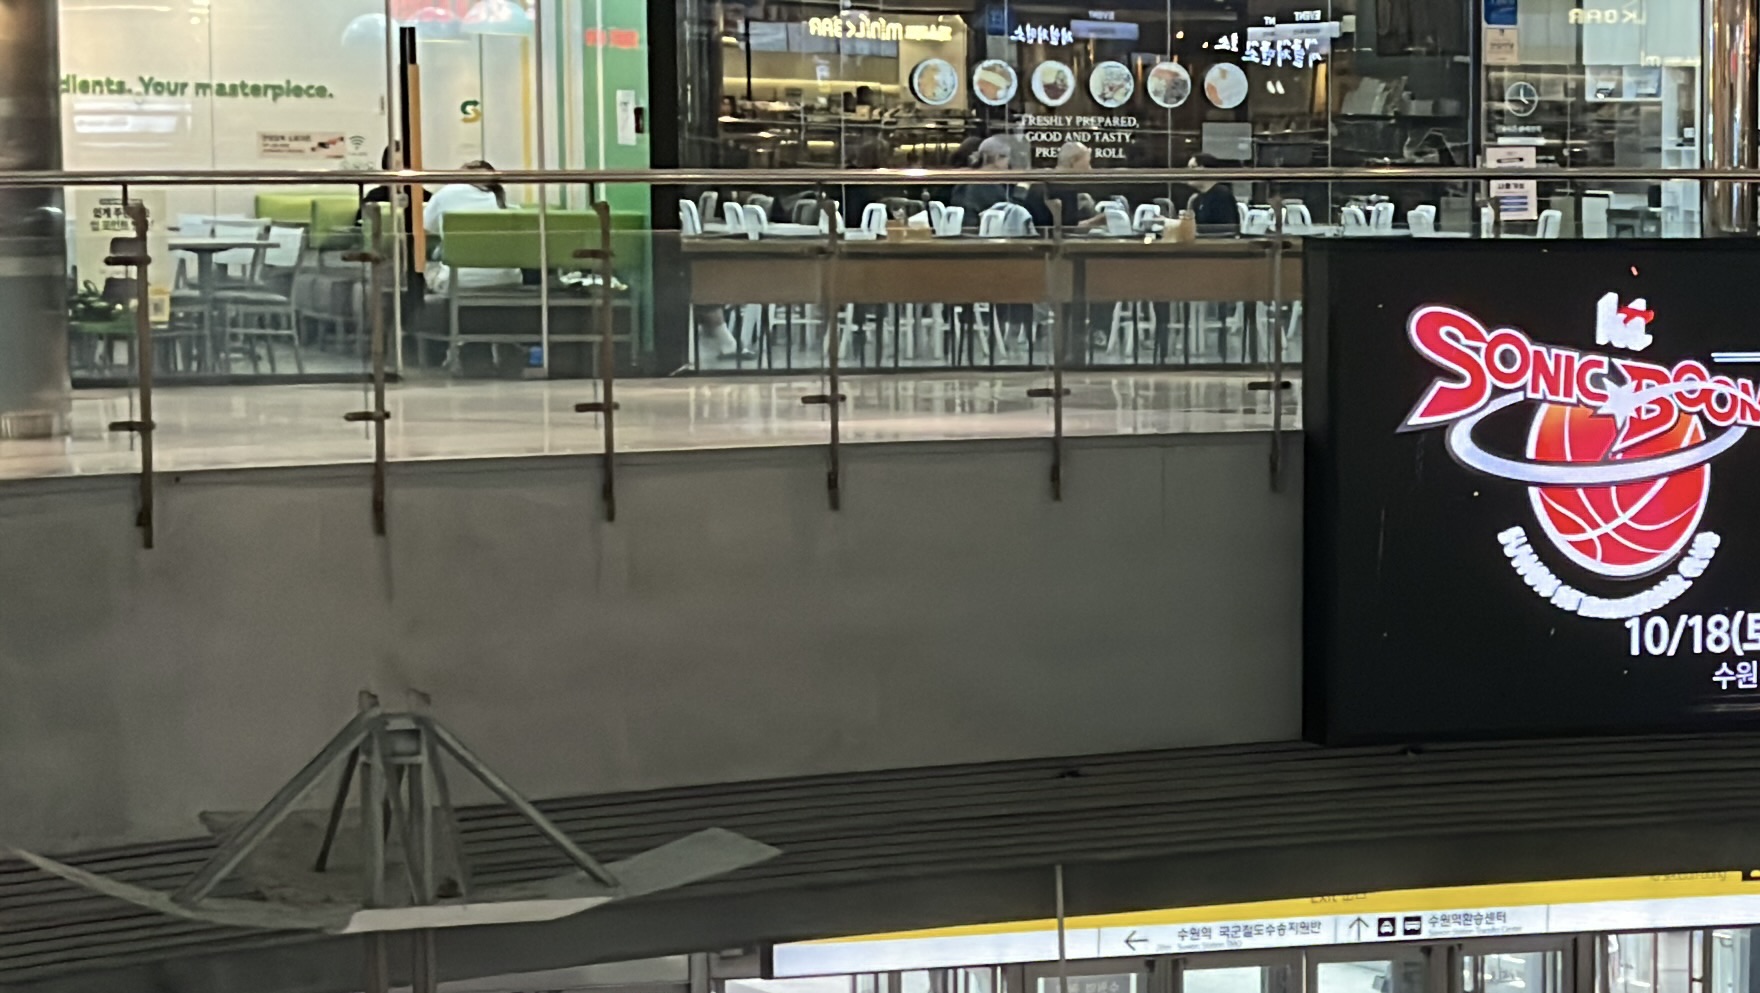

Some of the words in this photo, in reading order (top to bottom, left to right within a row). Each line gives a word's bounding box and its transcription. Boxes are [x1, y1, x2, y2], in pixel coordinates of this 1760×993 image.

[138, 76, 188, 97] Your
[195, 79, 334, 102] masterpiece.
[1022, 114, 1073, 127] FRESHLY
[1076, 115, 1139, 128] PREPARED,
[1025, 131, 1062, 142] GOOD
[1065, 132, 1091, 143] AND
[1093, 132, 1135, 144] TASTY,
[1095, 147, 1125, 158] ROLL
[1712, 660, 1758, 690] 수원
[1178, 926, 1212, 941] 수원역
